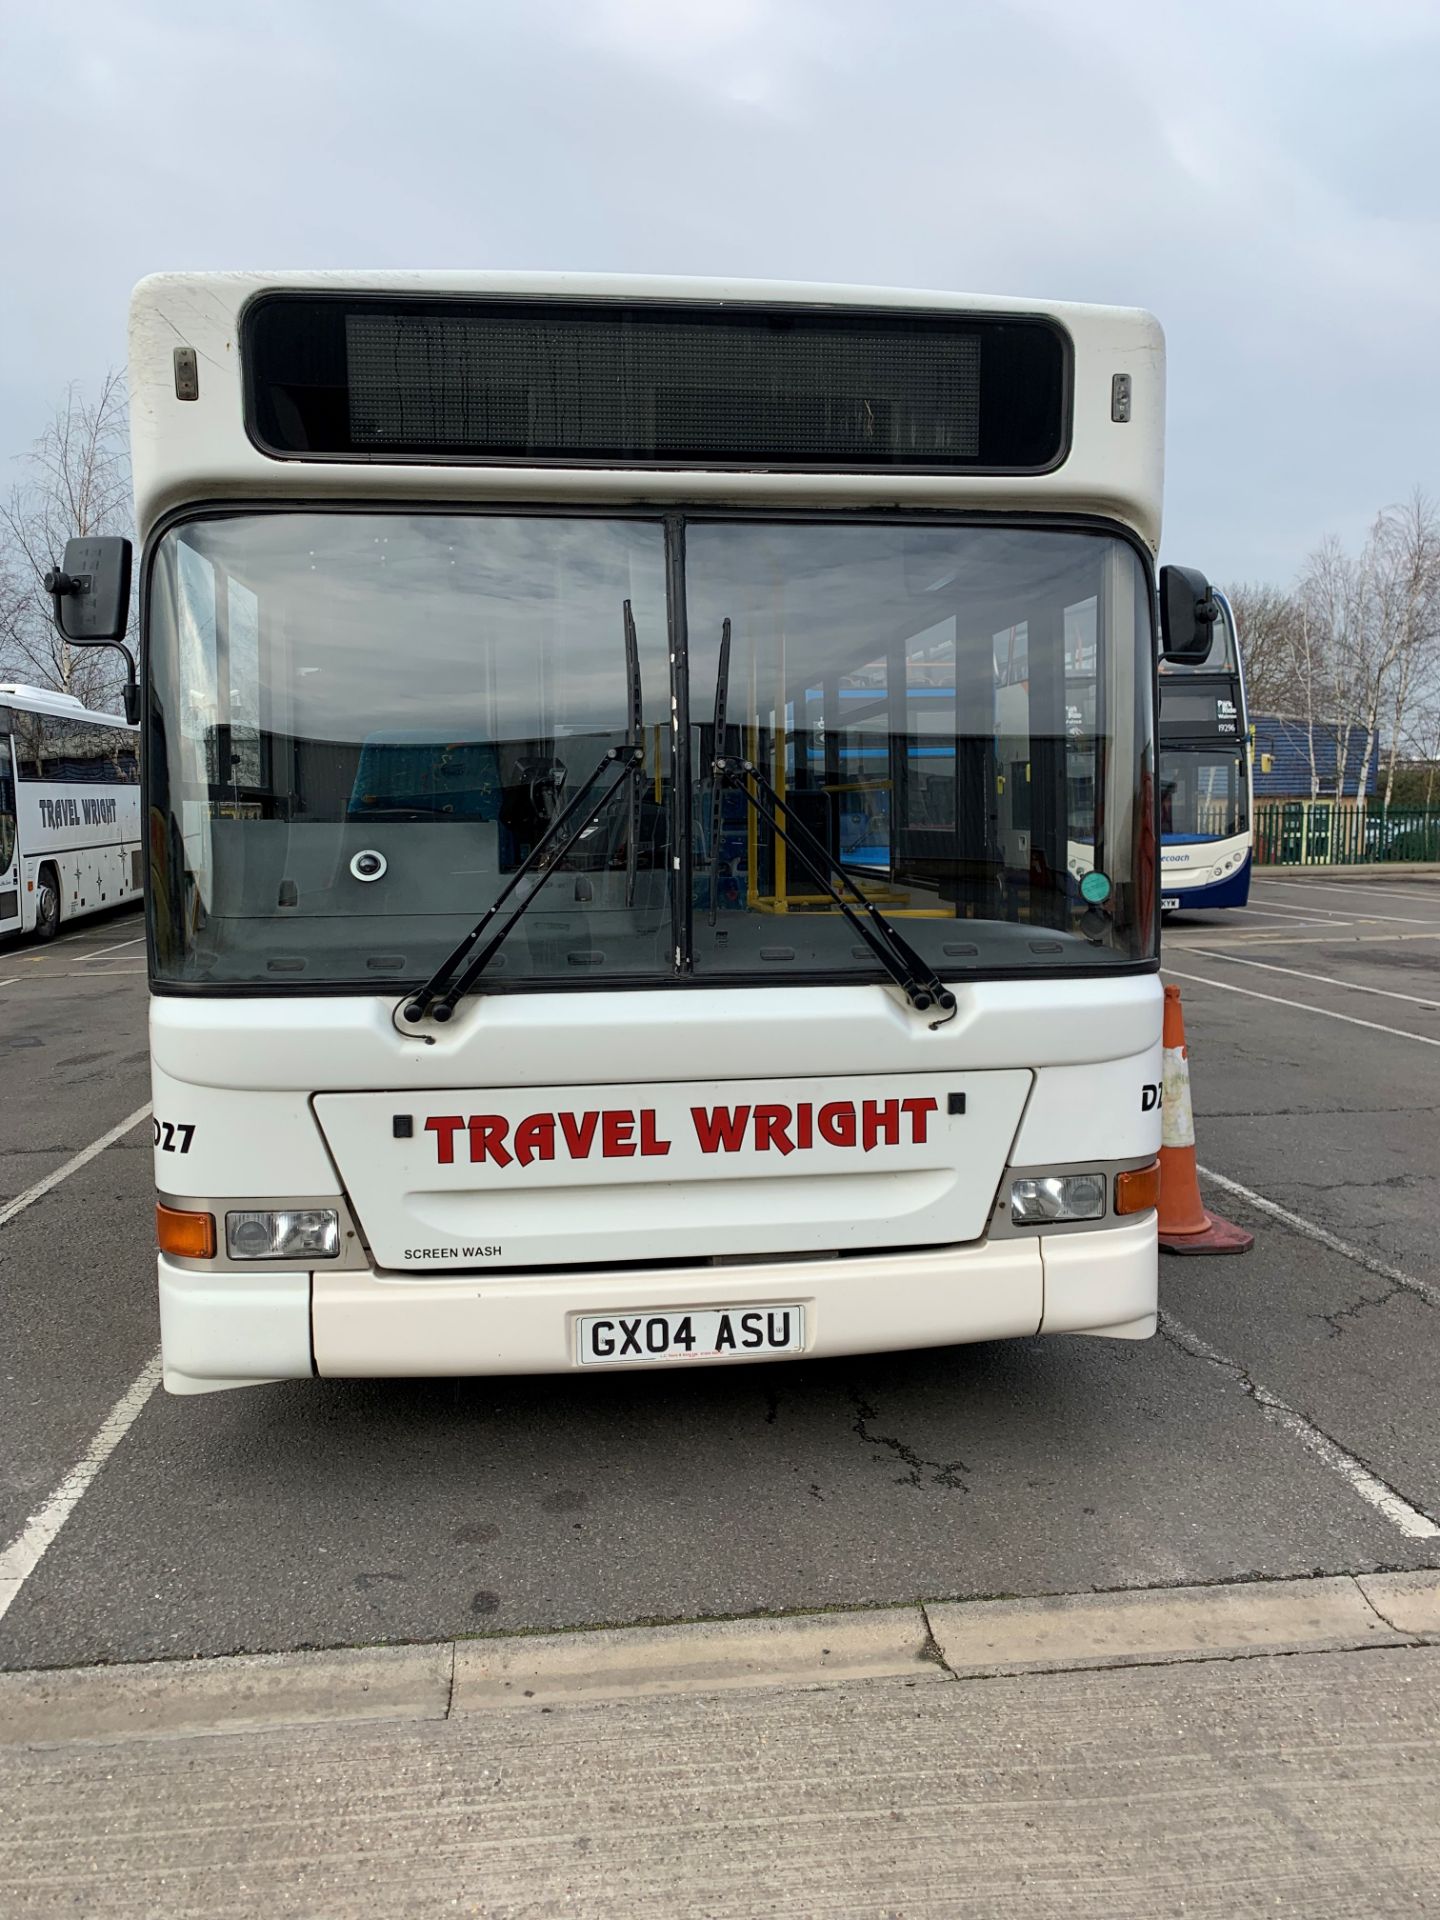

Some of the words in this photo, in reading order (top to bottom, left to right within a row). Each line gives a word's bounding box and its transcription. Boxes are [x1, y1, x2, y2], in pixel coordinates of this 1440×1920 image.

[39, 799, 80, 829] TRAVEL
[81, 798, 117, 826] WRIGHT
[424, 1108, 672, 1168] TRAVEL
[690, 1097, 939, 1156] WRIGHT
[404, 1247, 458, 1259] SCREEN
[462, 1240, 502, 1257] WASH
[591, 1316, 696, 1357] GX04
[715, 1311, 790, 1352] ASU
